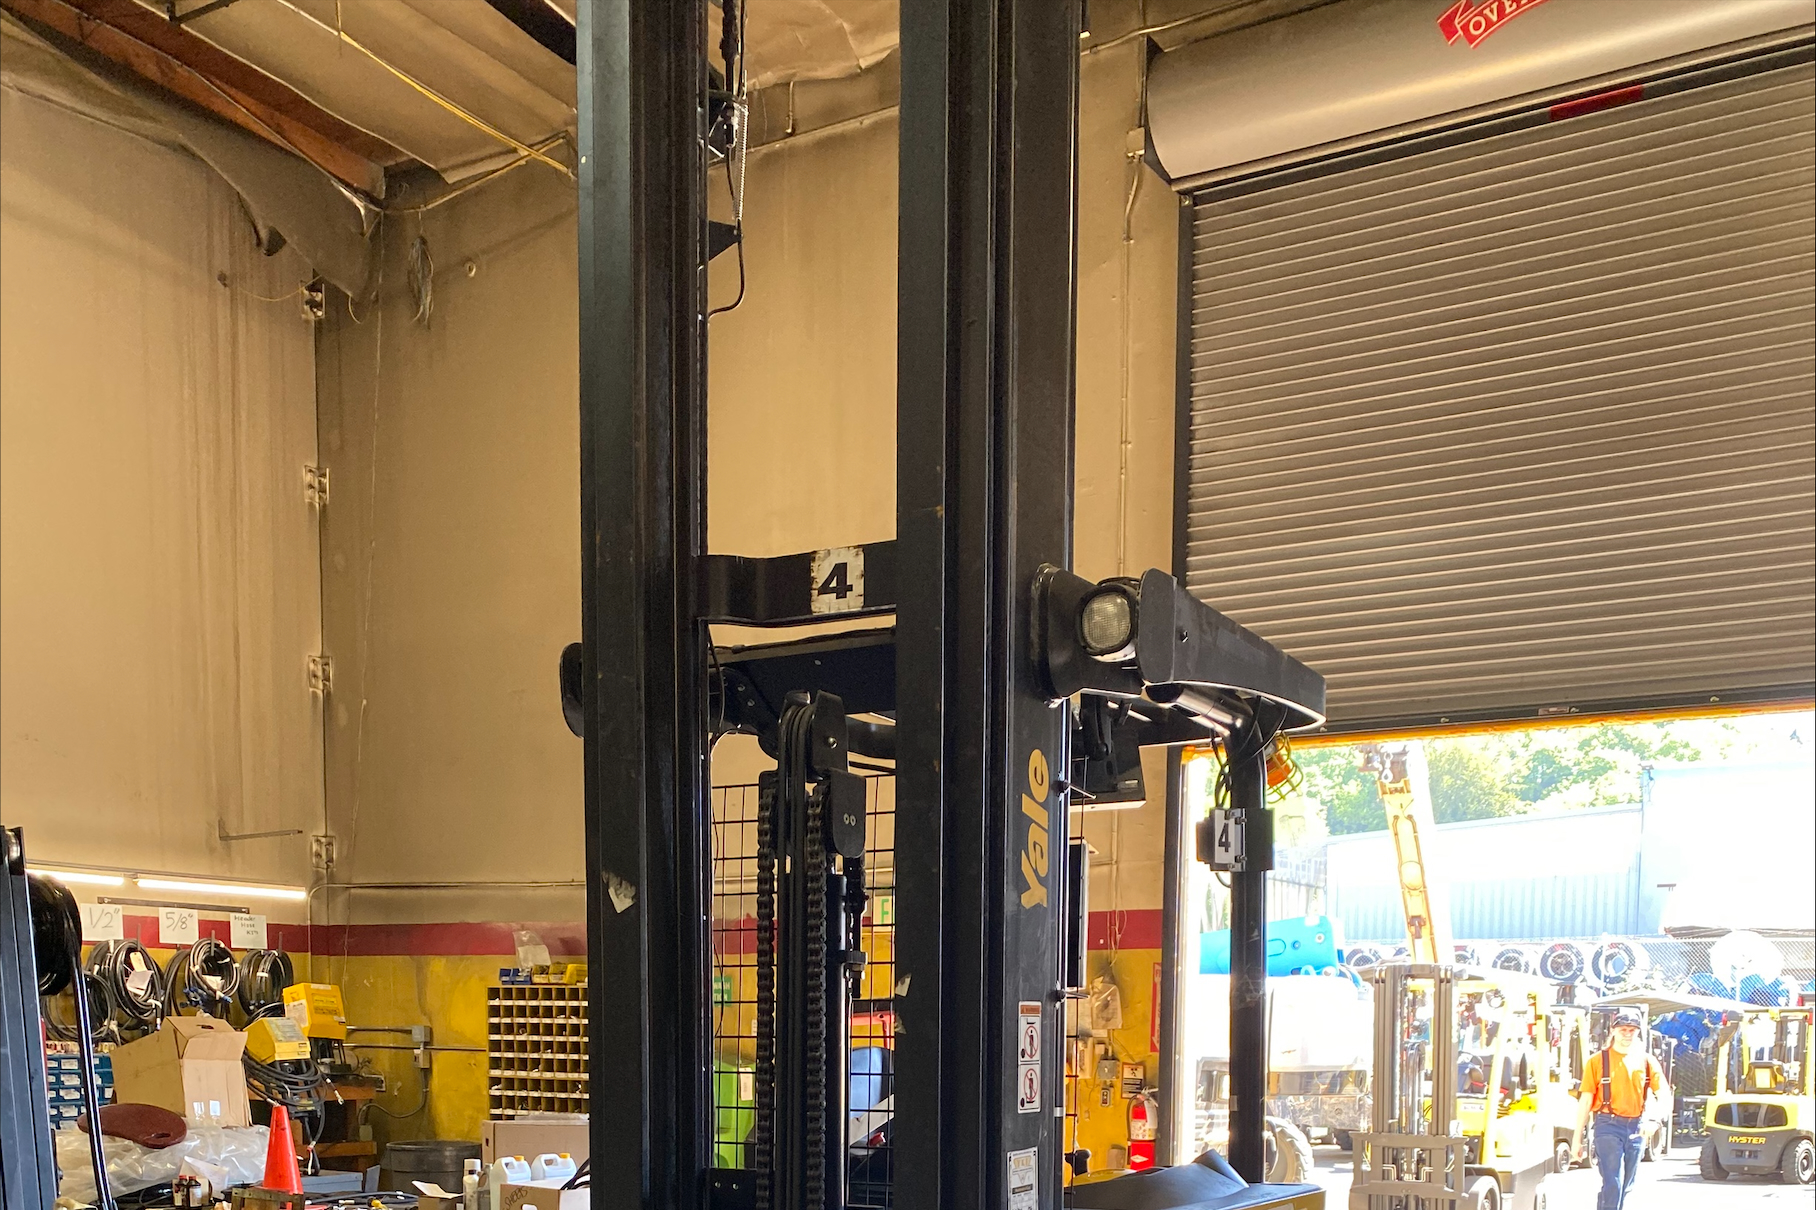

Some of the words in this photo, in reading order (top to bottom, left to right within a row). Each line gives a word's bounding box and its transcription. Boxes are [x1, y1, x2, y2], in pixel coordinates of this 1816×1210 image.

[1469, 0, 1529, 35] OVE
[818, 562, 853, 599] 4
[1021, 749, 1049, 909] Yale
[1218, 823, 1231, 853] 4
[89, 906, 120, 929] 1/2"
[165, 912, 194, 931] 5/8"
[1728, 1135, 1766, 1144] HYSTER
